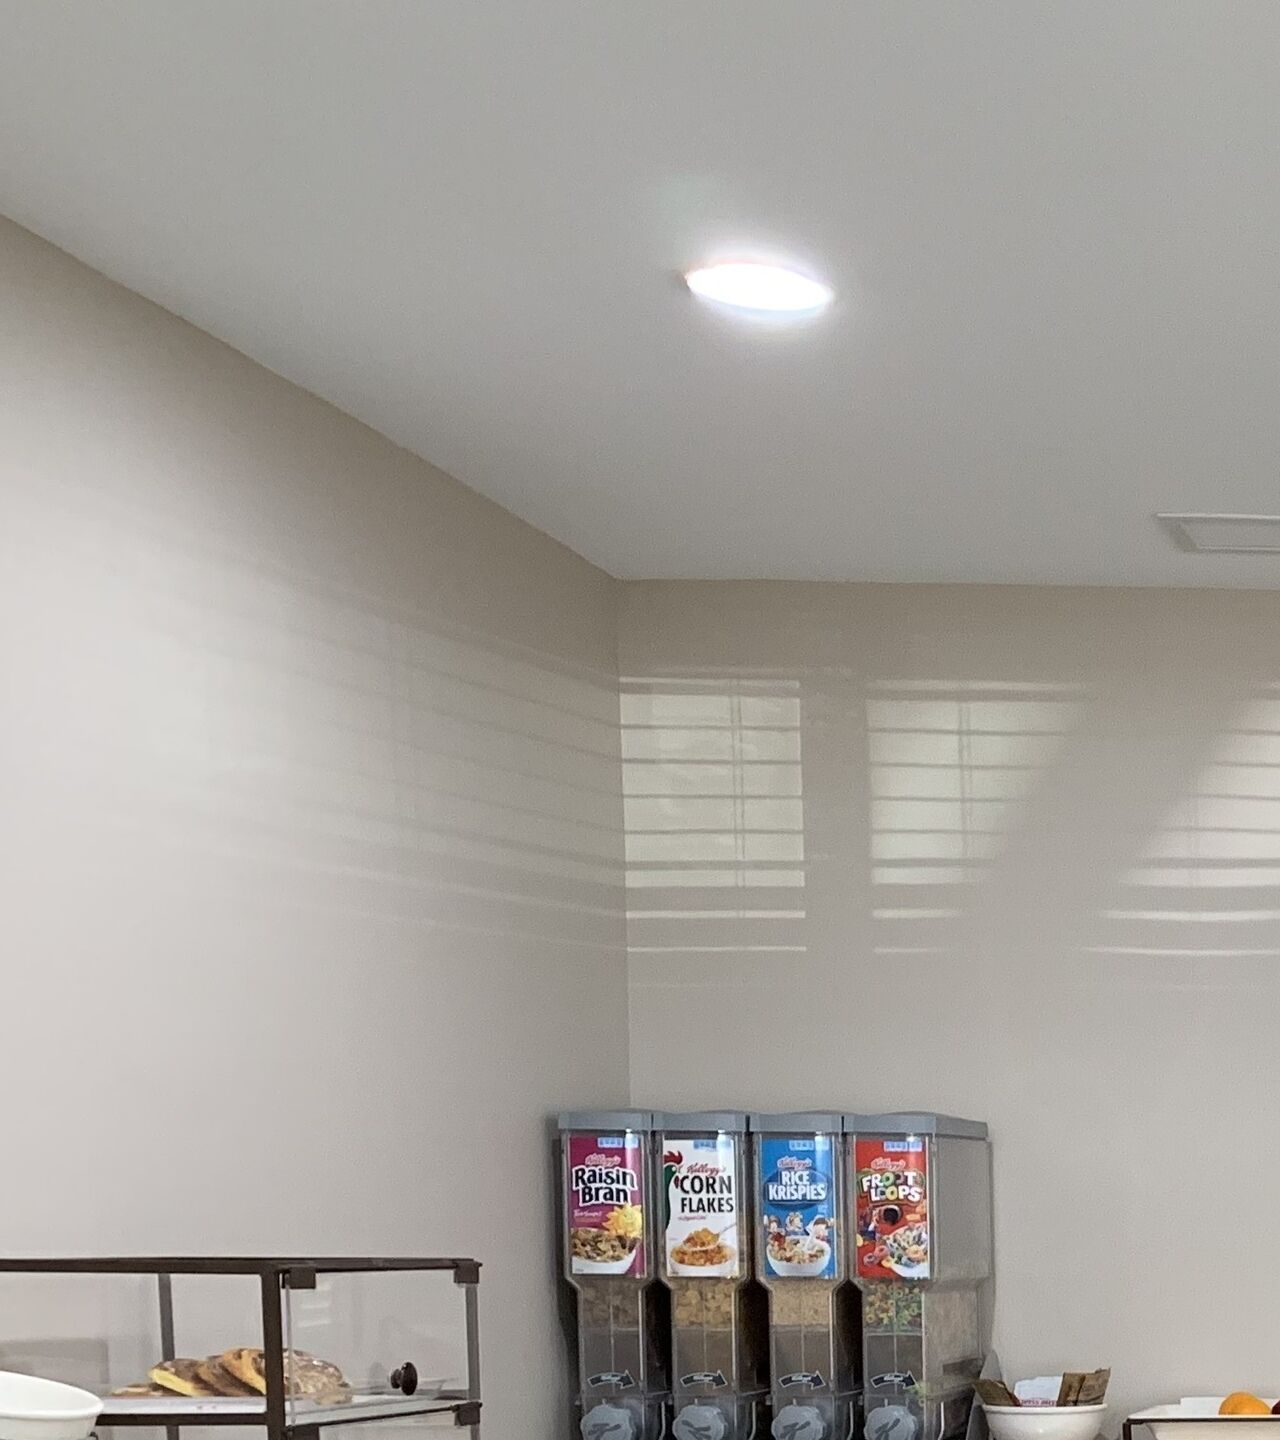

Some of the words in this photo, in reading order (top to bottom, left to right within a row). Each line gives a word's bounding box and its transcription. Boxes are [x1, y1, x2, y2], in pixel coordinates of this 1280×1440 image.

[574, 1166, 636, 1188] Raisin
[680, 1176, 732, 1194] CORN
[782, 1171, 810, 1184] RICE
[861, 1172, 916, 1191] FROOT
[581, 1185, 629, 1203] Bran
[768, 1184, 826, 1200] KRISPIES
[870, 1186, 921, 1202] LOOPS
[681, 1197, 734, 1213] FLAKES
